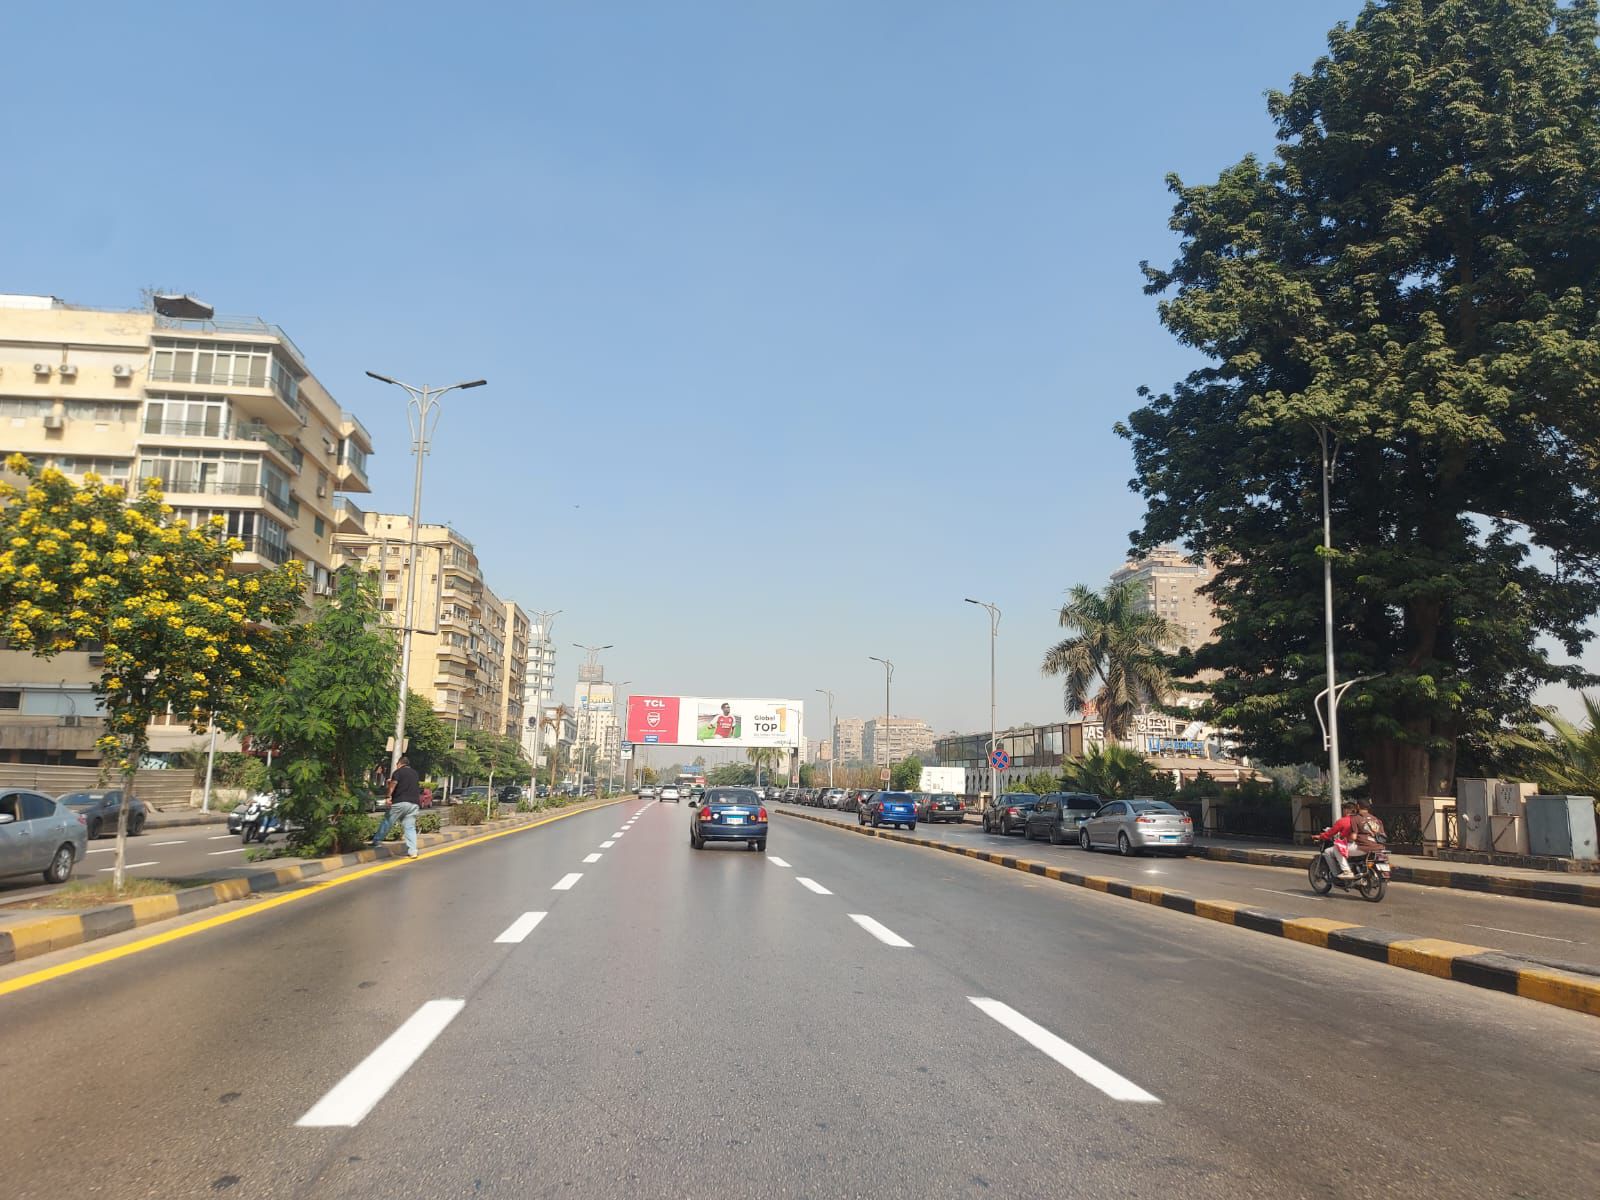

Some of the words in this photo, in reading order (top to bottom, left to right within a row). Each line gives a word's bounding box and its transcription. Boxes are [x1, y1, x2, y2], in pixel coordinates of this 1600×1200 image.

[643, 699, 665, 707] TCL
[754, 723, 778, 732] TOP
[775, 707, 787, 732] 1
